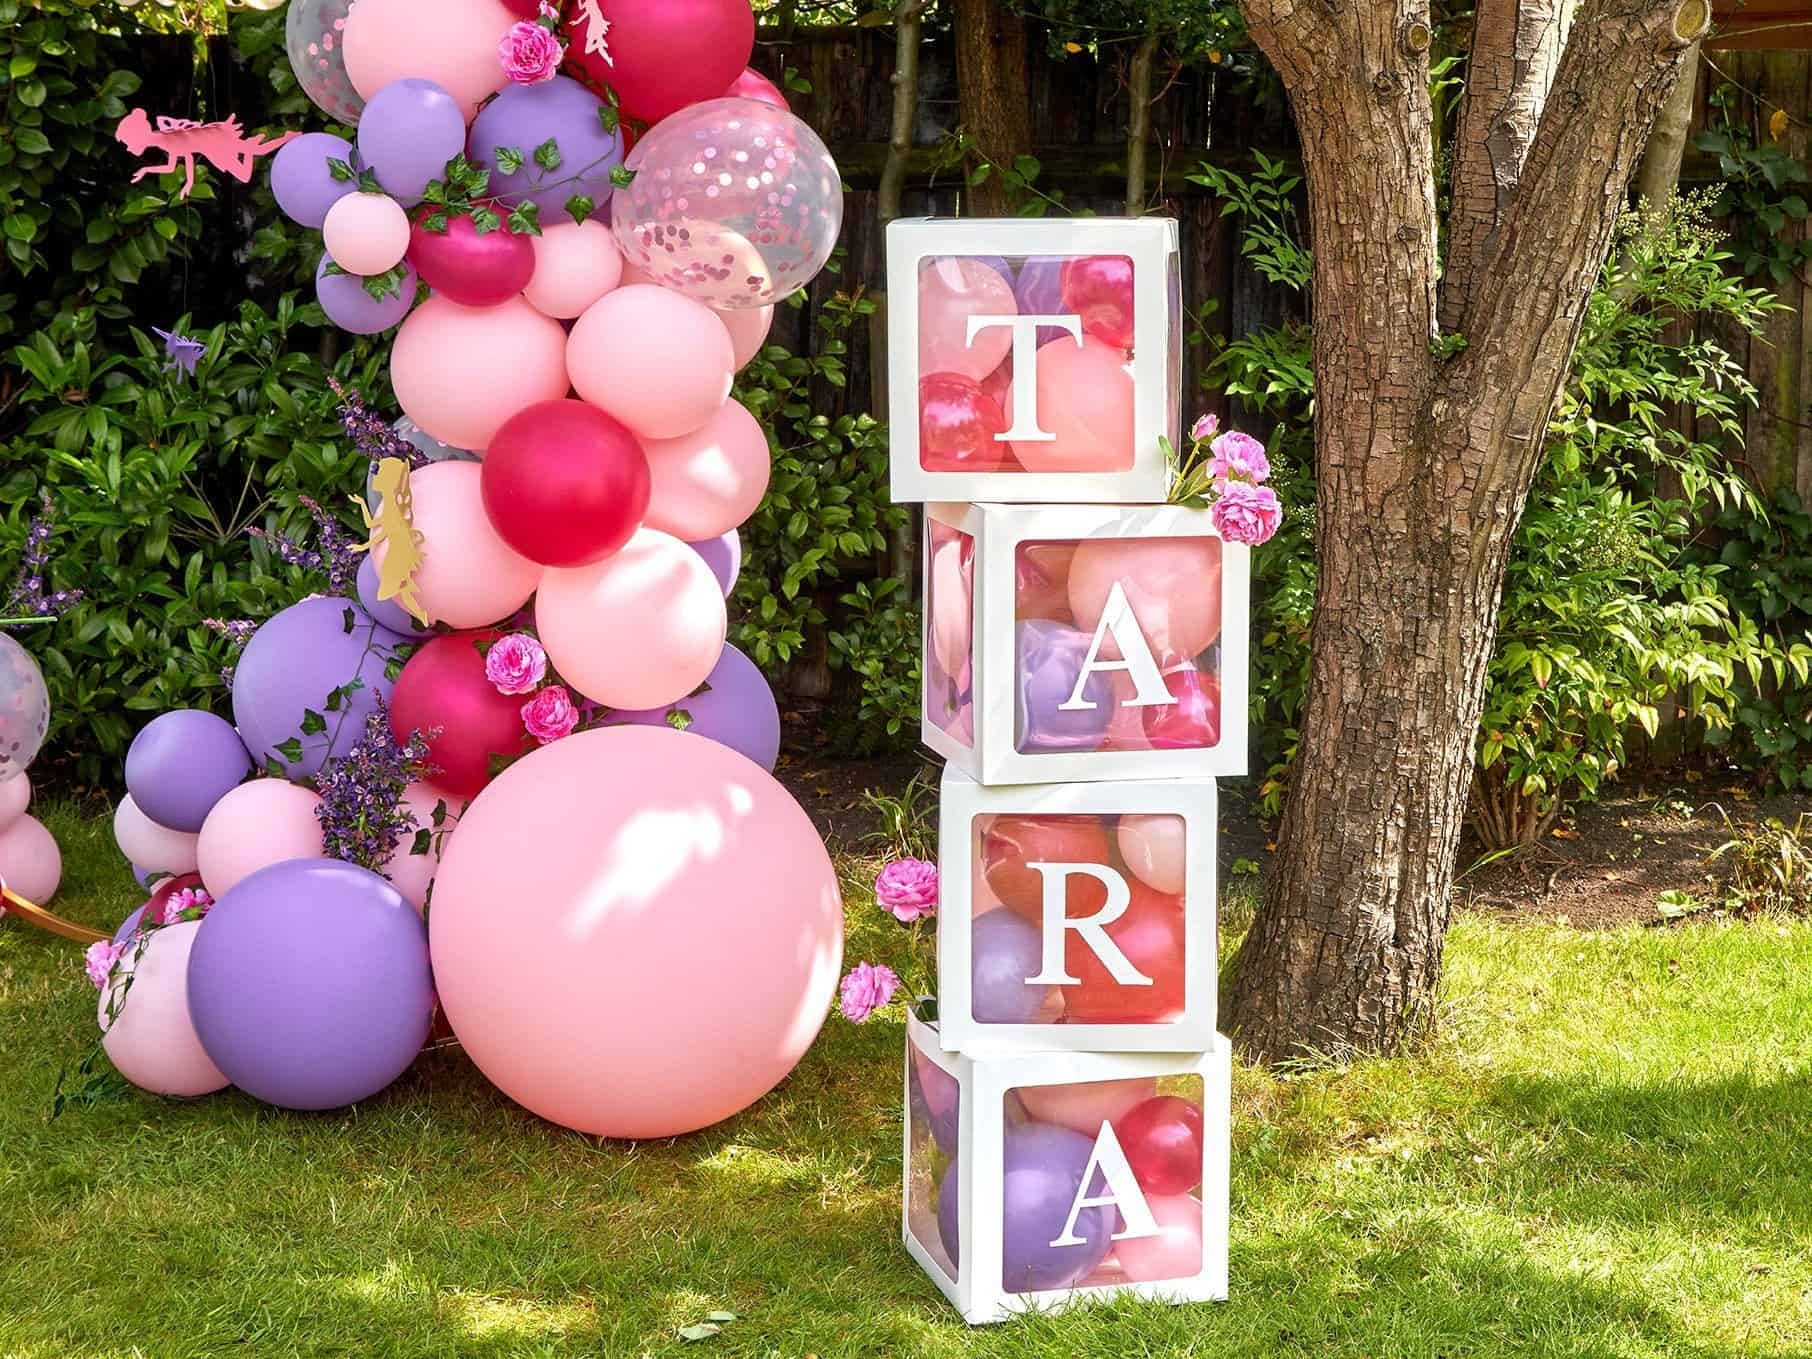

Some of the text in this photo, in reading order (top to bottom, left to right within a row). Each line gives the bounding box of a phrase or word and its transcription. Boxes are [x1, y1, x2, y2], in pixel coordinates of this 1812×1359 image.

[965, 314, 1083, 442] T
[1058, 581, 1178, 710] A
[1025, 862, 1153, 985] R
[1049, 1120, 1162, 1248] A
